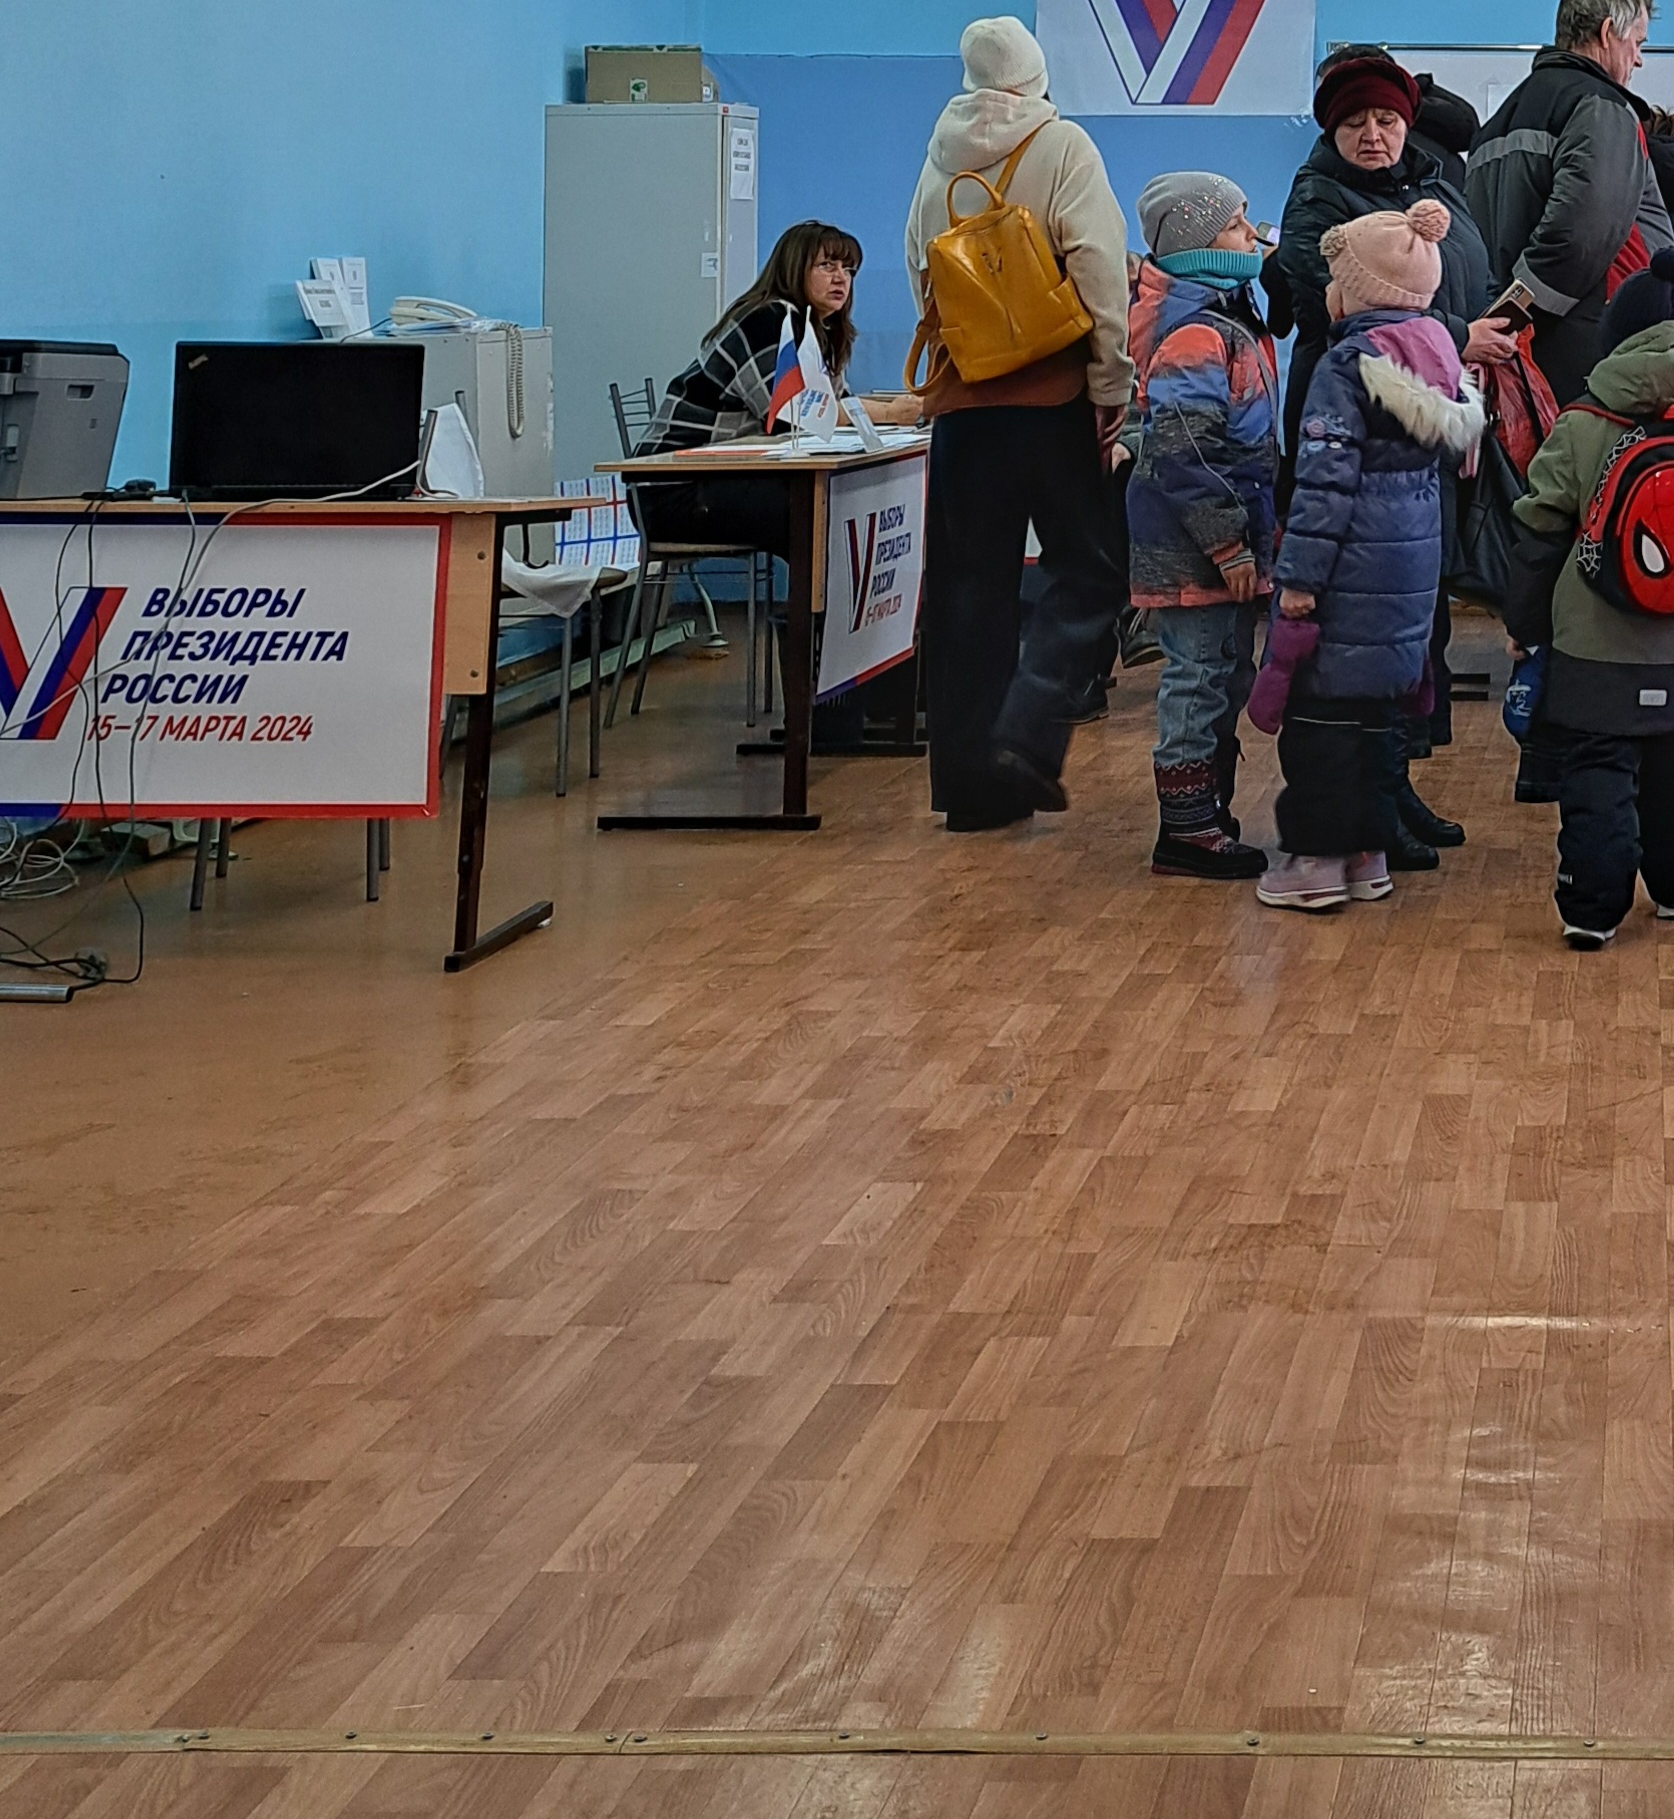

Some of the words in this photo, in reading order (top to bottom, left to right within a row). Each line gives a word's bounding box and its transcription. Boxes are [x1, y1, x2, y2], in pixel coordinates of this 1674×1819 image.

[141, 587, 306, 618] ВЫБОРЫ
[120, 630, 349, 666] ПРЕЗИДЕНТА
[100, 673, 249, 704] РОССИИ
[159, 715, 248, 741] МАРТА
[250, 715, 314, 741] 2024
